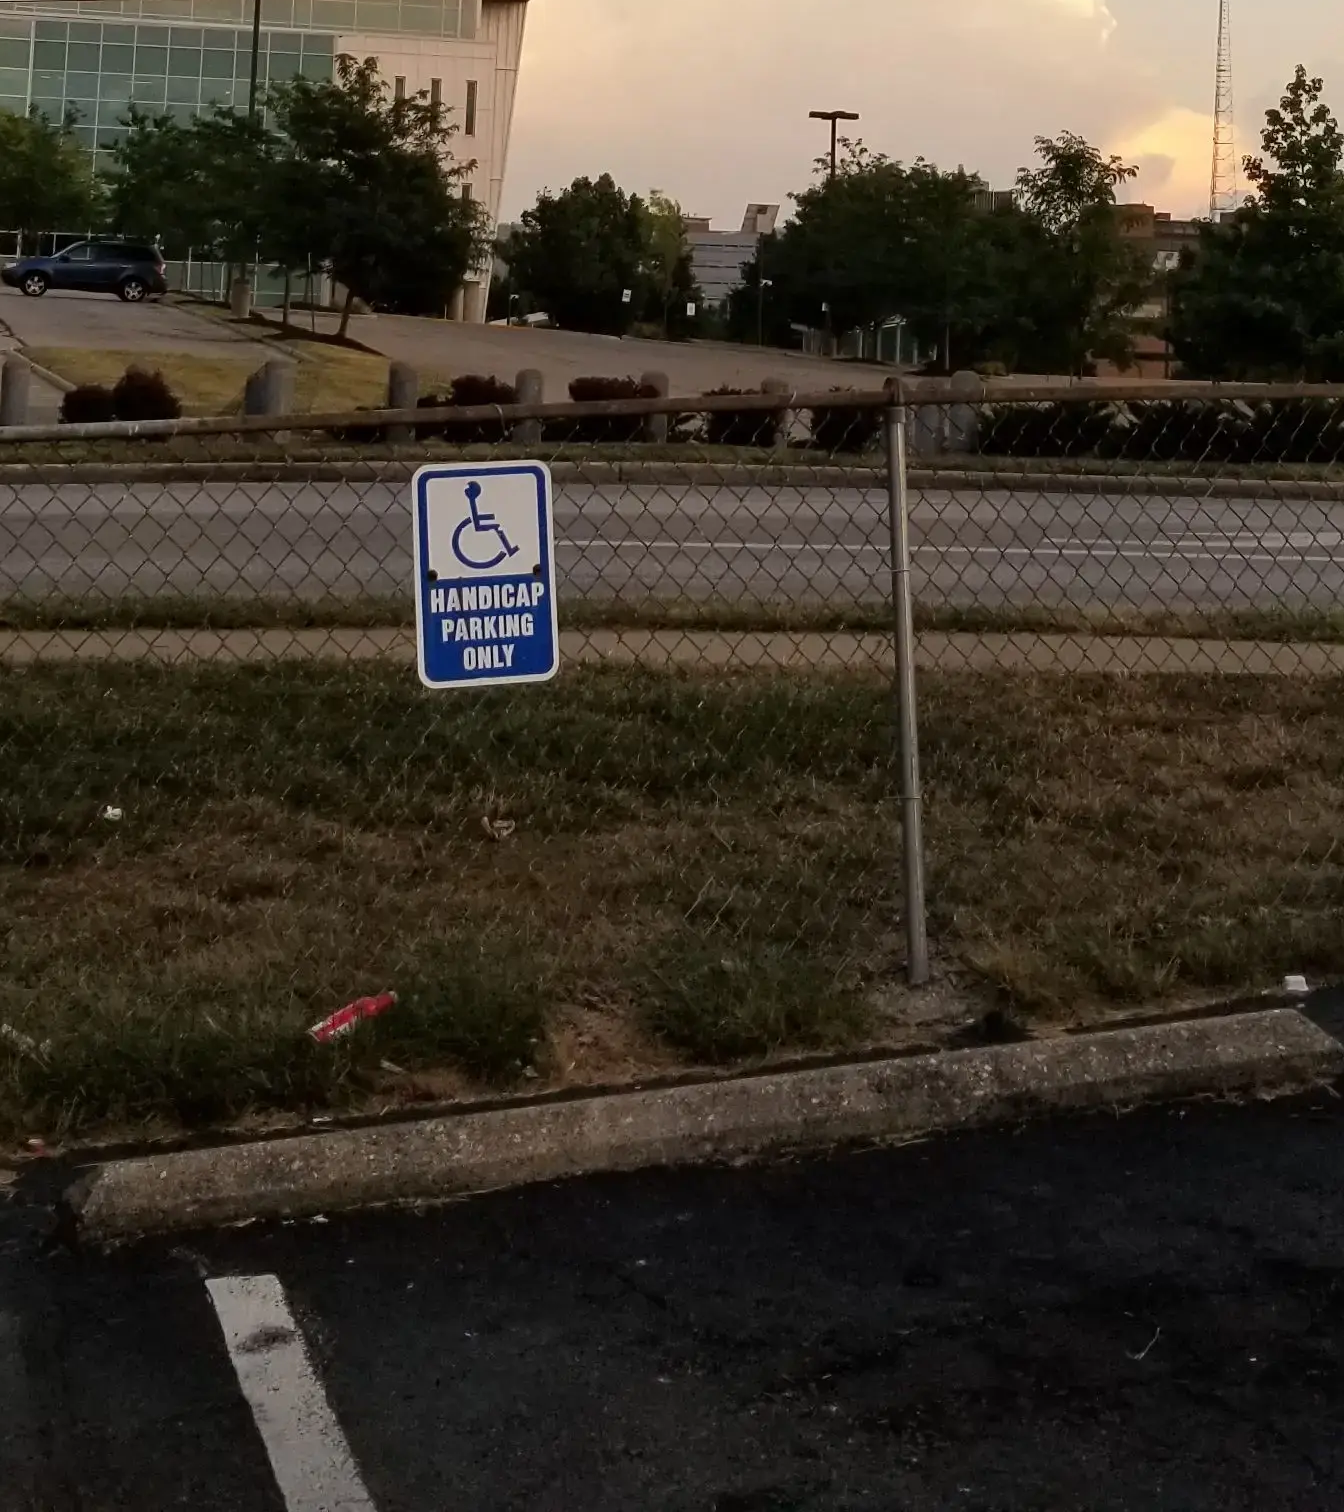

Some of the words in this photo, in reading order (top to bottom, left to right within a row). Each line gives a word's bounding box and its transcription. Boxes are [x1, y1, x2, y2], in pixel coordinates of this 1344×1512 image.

[430, 581, 545, 614] HANDICAP
[441, 613, 534, 643] PARKING
[463, 643, 515, 671] ONLY
